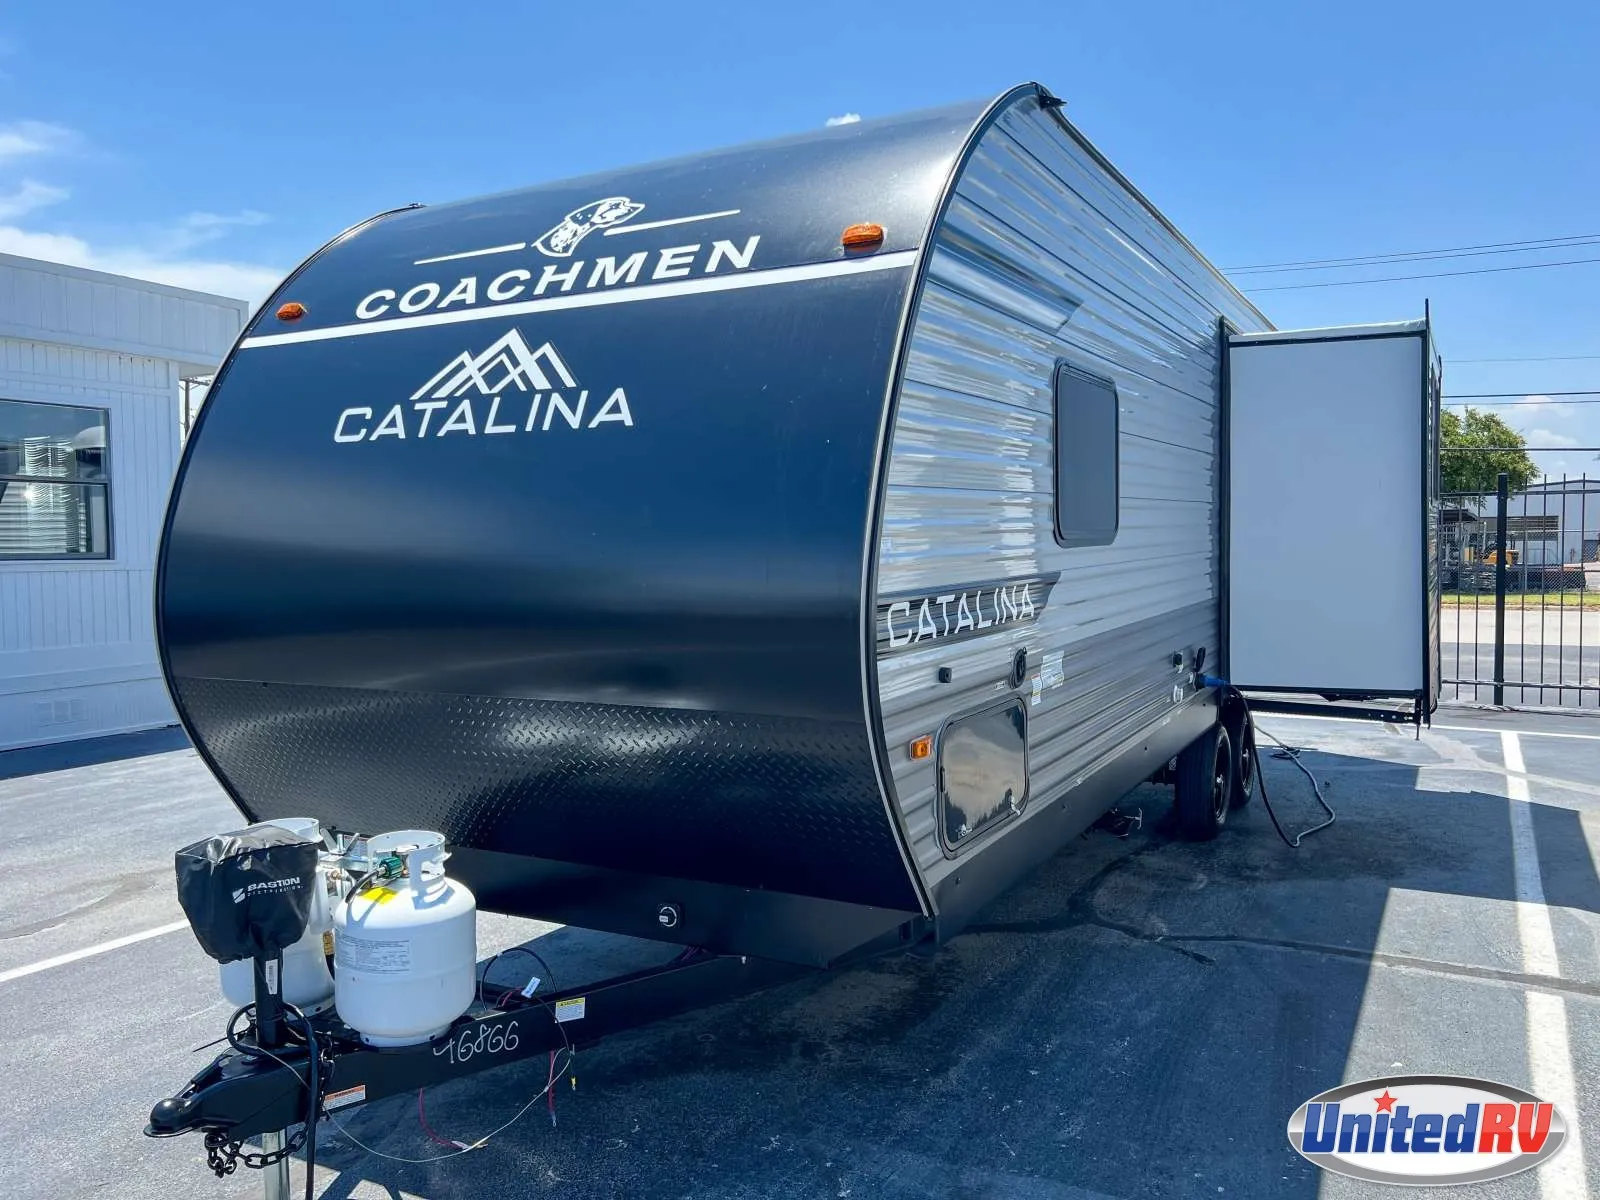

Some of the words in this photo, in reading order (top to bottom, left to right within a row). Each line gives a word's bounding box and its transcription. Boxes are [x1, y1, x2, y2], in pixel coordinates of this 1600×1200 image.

[355, 235, 761, 320] COACHMEN
[333, 387, 634, 443] CATALINA
[887, 583, 1035, 648] CATALINA
